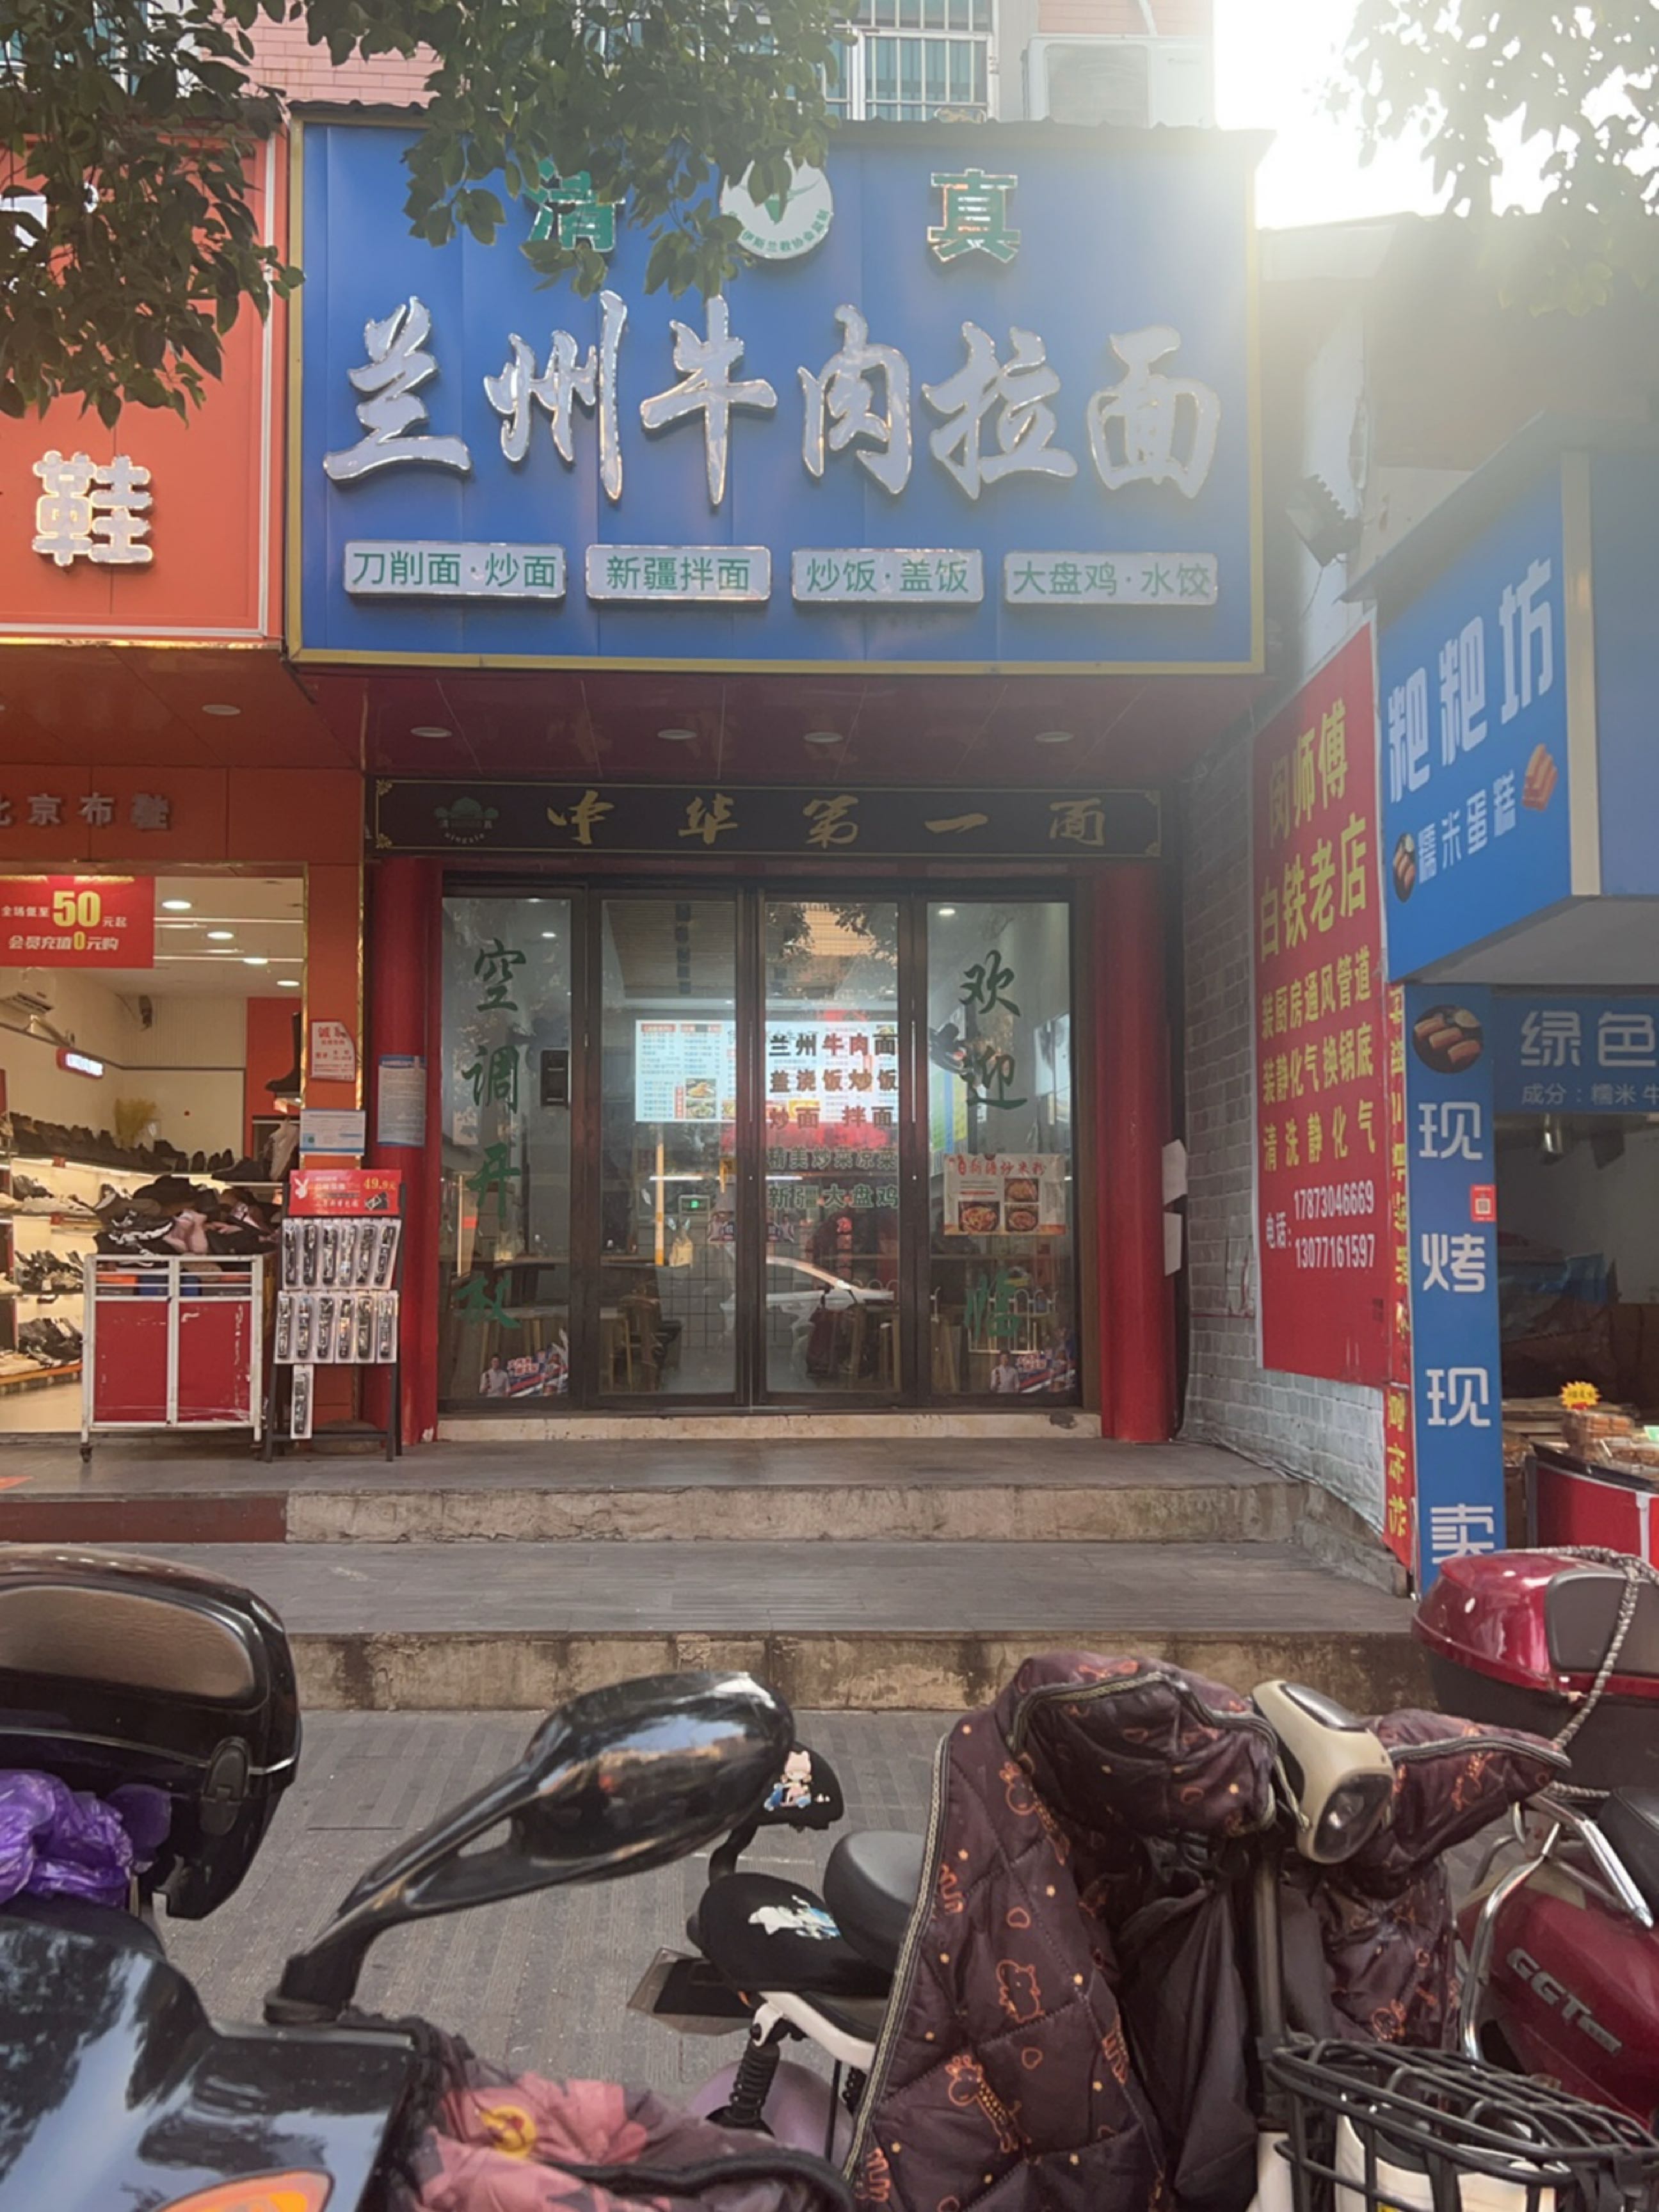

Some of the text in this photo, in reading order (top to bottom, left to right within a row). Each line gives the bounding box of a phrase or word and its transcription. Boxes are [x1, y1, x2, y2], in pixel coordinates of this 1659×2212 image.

[730, 209, 831, 252] 伊斯兰教协会监制
[927, 168, 1022, 264] 真
[323, 289, 1221, 506] 兰州牛肉拉面
[32, 450, 155, 567] 鞋
[352, 551, 556, 588] 刀削面·炒面
[605, 556, 750, 592] 新疆拌面
[806, 558, 969, 594] 炒饭·盖饭
[1013, 561, 1211, 598] 大盘鸡·水饺
[1388, 556, 1554, 804] 粑粑坊
[546, 789, 1106, 848] 中华第一面
[1418, 769, 1516, 884] 糯米蛋糕
[1261, 812, 1366, 963] 白铁老店
[768, 1032, 898, 1057] 兰州牛肉面
[1520, 1010, 1650, 1068] 绿色
[459, 938, 527, 1329] 空调开放
[768, 1184, 898, 1209] 新疆大盘鸡
[1294, 1180, 1374, 1221] 17873046669
[1295, 1233, 1375, 1269] 13077161597
[1418, 1102, 1495, 1564] 现烤现卖
